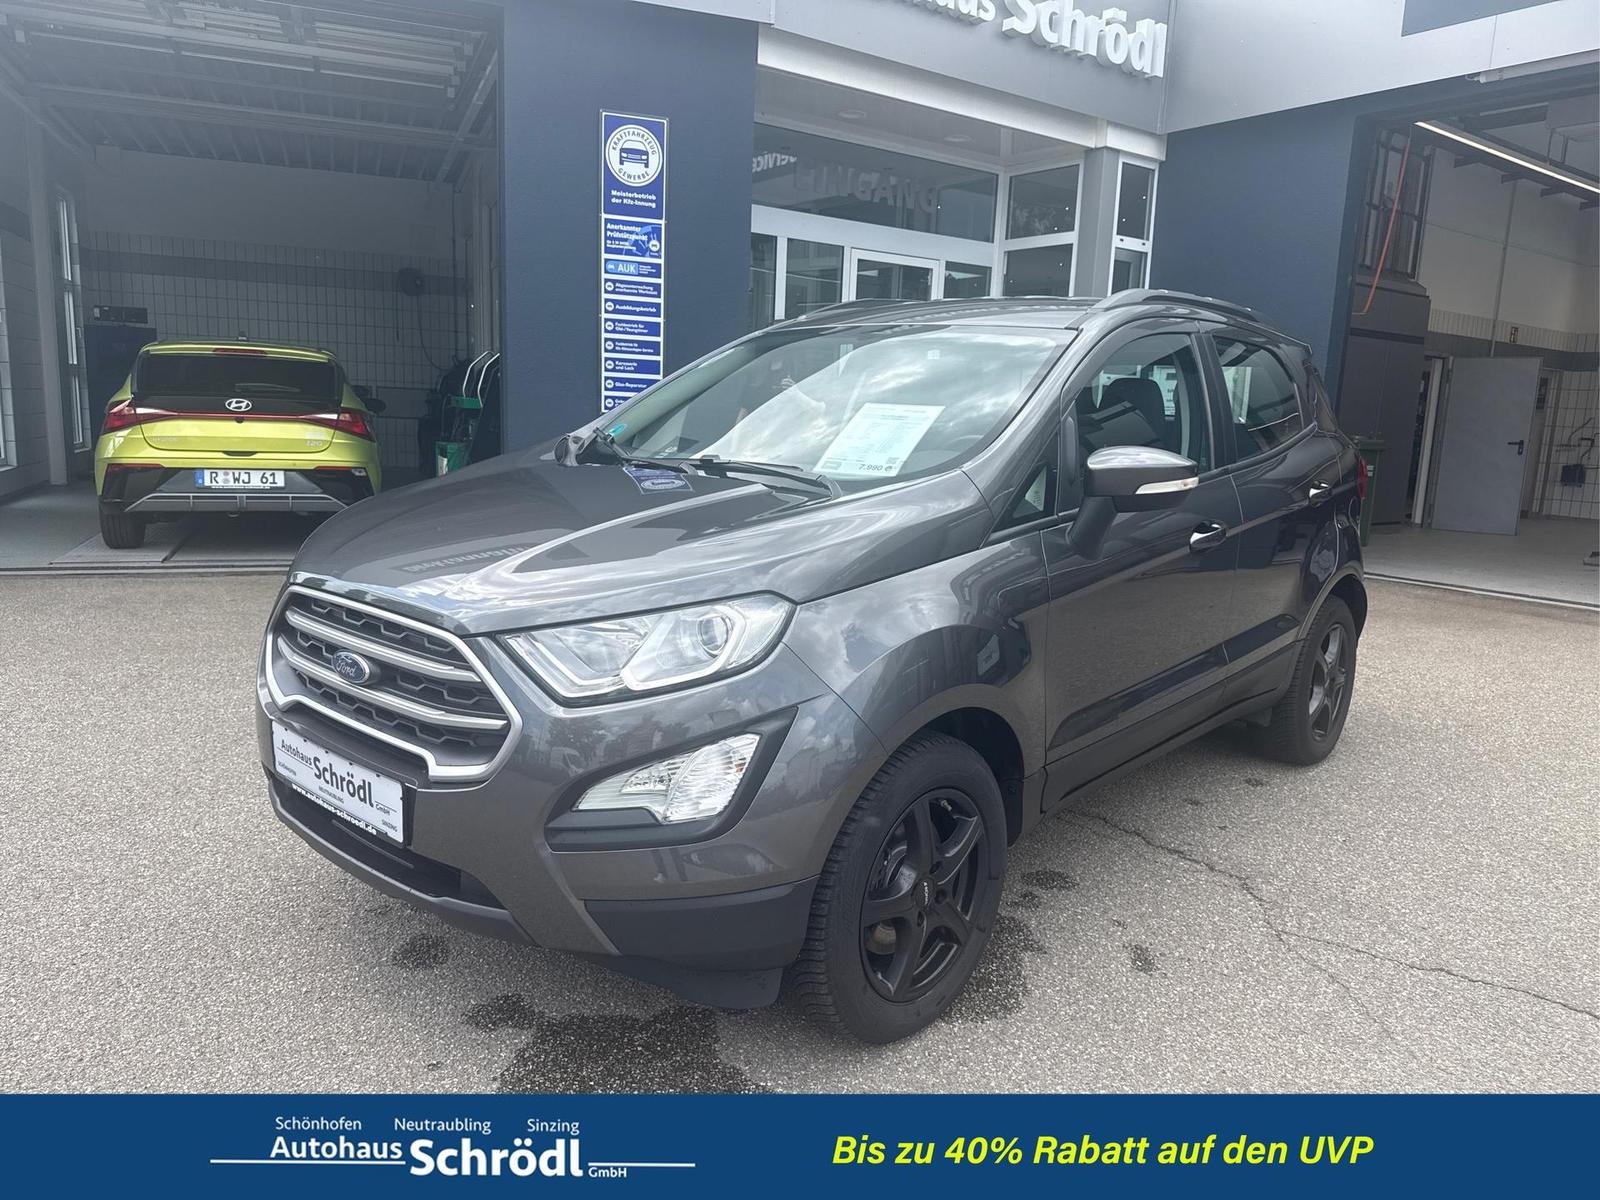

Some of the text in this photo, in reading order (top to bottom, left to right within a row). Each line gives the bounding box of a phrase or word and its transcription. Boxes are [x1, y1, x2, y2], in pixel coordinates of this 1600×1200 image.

[1002, 0, 1167, 78] Schrödl
[612, 130, 657, 155] KRAFTFAHRZEUG
[618, 167, 650, 181] GEWERBE
[611, 190, 656, 201] Meisterbetrieb
[623, 199, 656, 209] Kfz-Innung
[617, 263, 636, 274] AUK
[209, 471, 278, 485] R WJ 61
[281, 739, 313, 766] Autohaus
[313, 756, 374, 808] Schrödl
